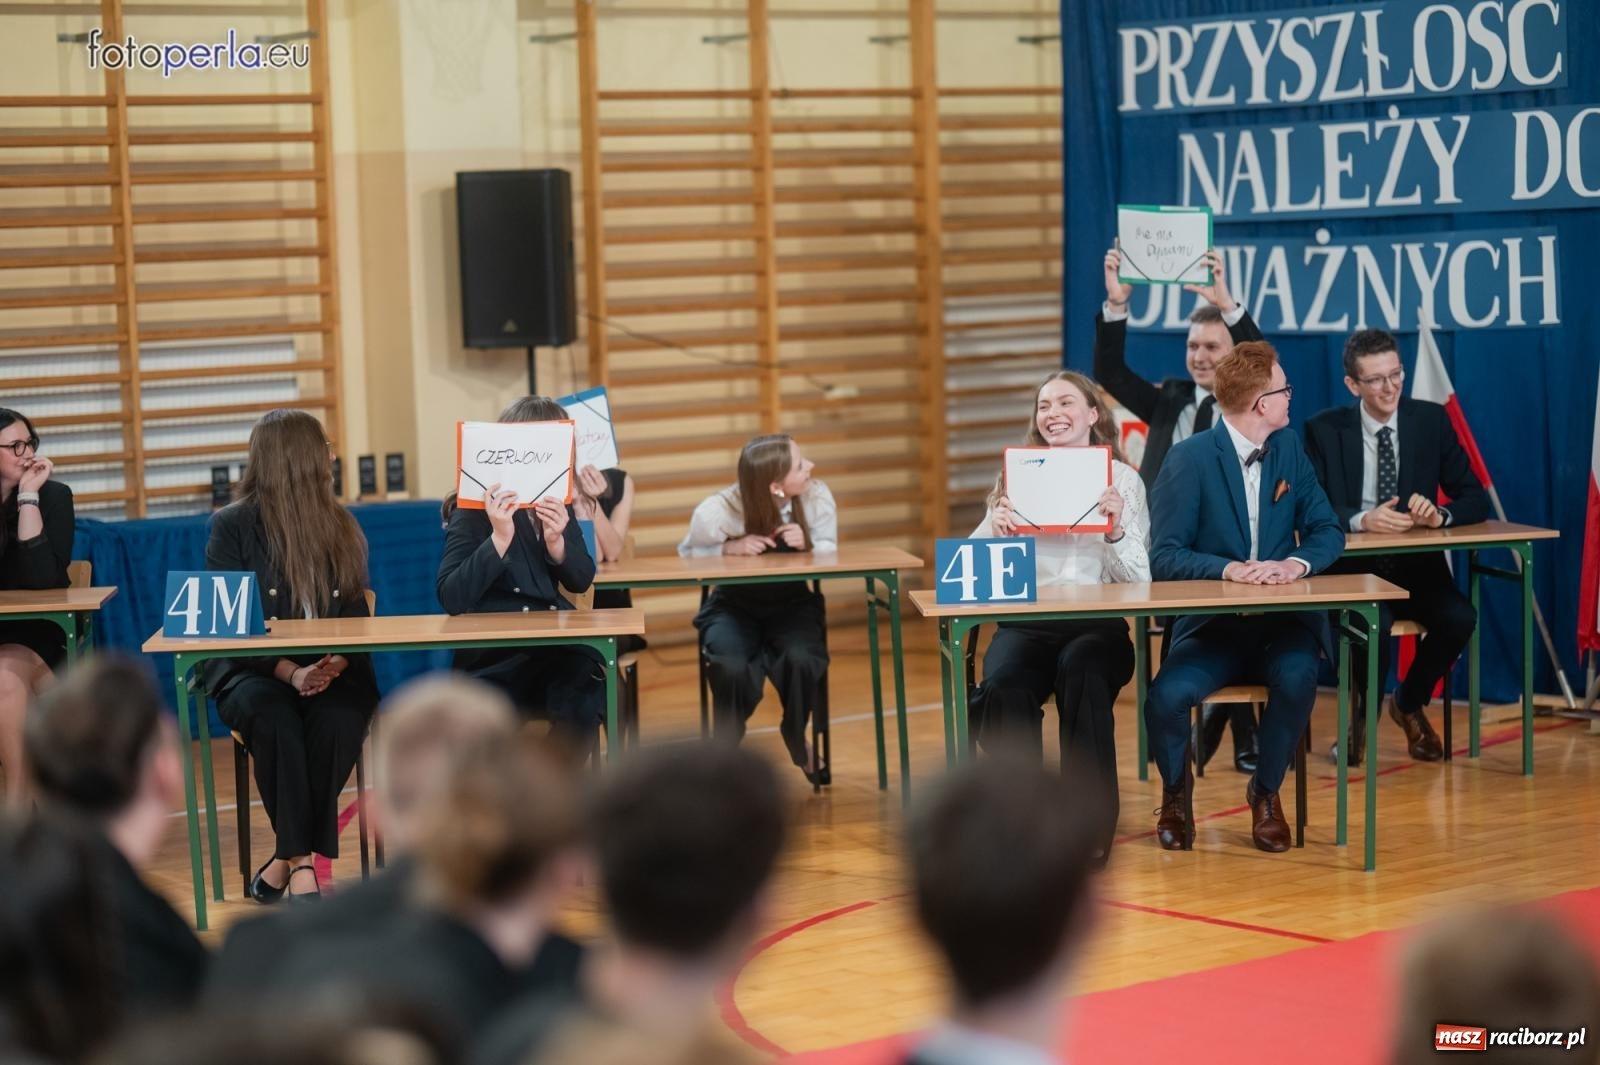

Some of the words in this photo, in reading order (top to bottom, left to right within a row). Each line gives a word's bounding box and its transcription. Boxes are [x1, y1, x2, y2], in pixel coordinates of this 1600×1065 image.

[1178, 105, 1470, 216] NALEŻY
[476, 448, 553, 465] CZERWONY
[941, 542, 1028, 601] 4E
[167, 576, 251, 635] 4M
